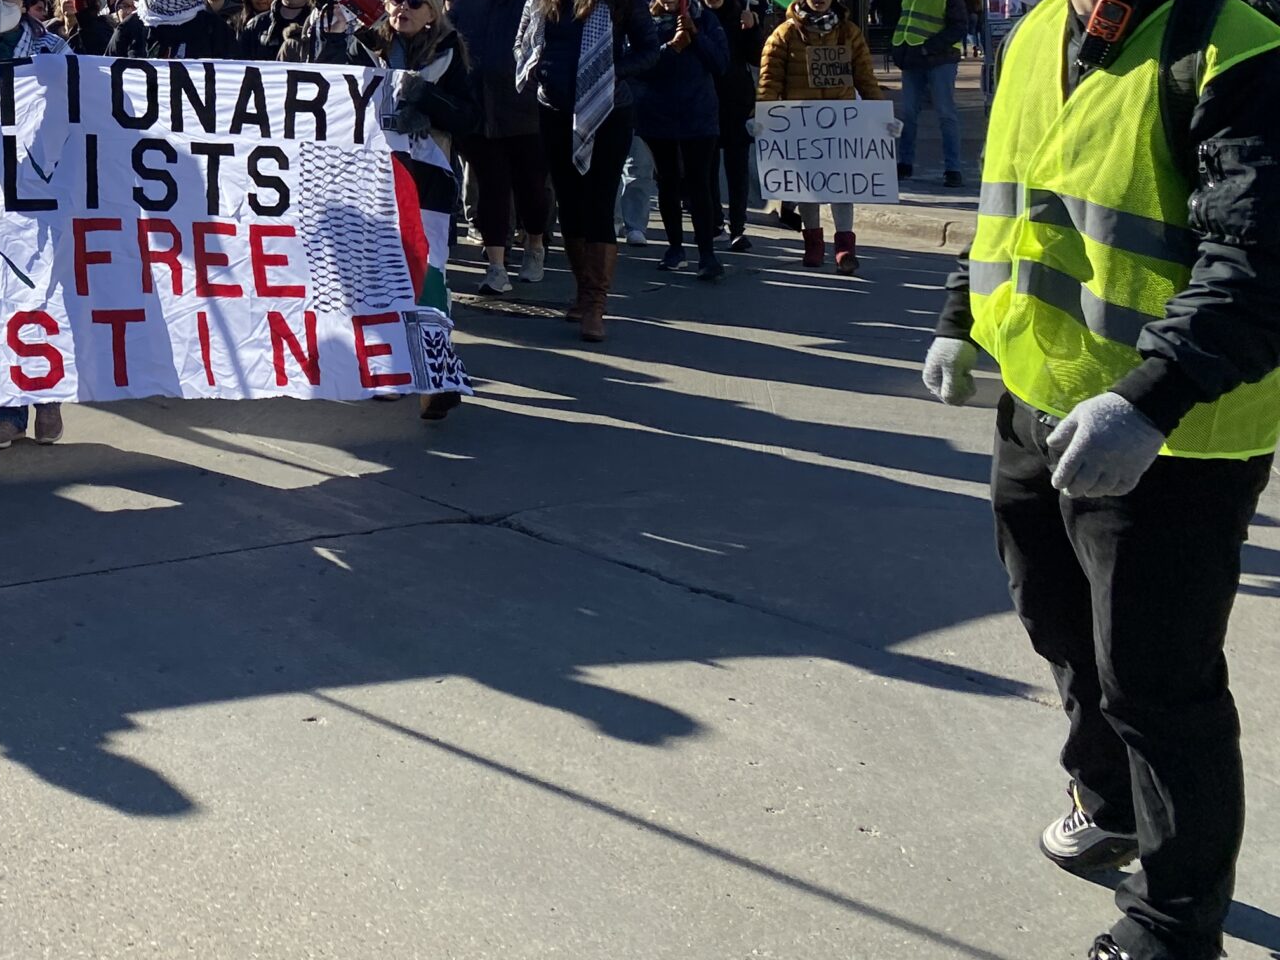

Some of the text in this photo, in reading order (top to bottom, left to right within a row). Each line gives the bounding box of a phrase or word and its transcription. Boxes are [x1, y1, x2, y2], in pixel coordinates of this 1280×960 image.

[812, 47, 845, 61] STOP
[813, 76, 845, 87] GAZA
[767, 105, 858, 133] STOP
[758, 137, 895, 161] PALESTINIAN
[763, 168, 887, 197] GENOCIDE
[73, 218, 306, 298] FREE
